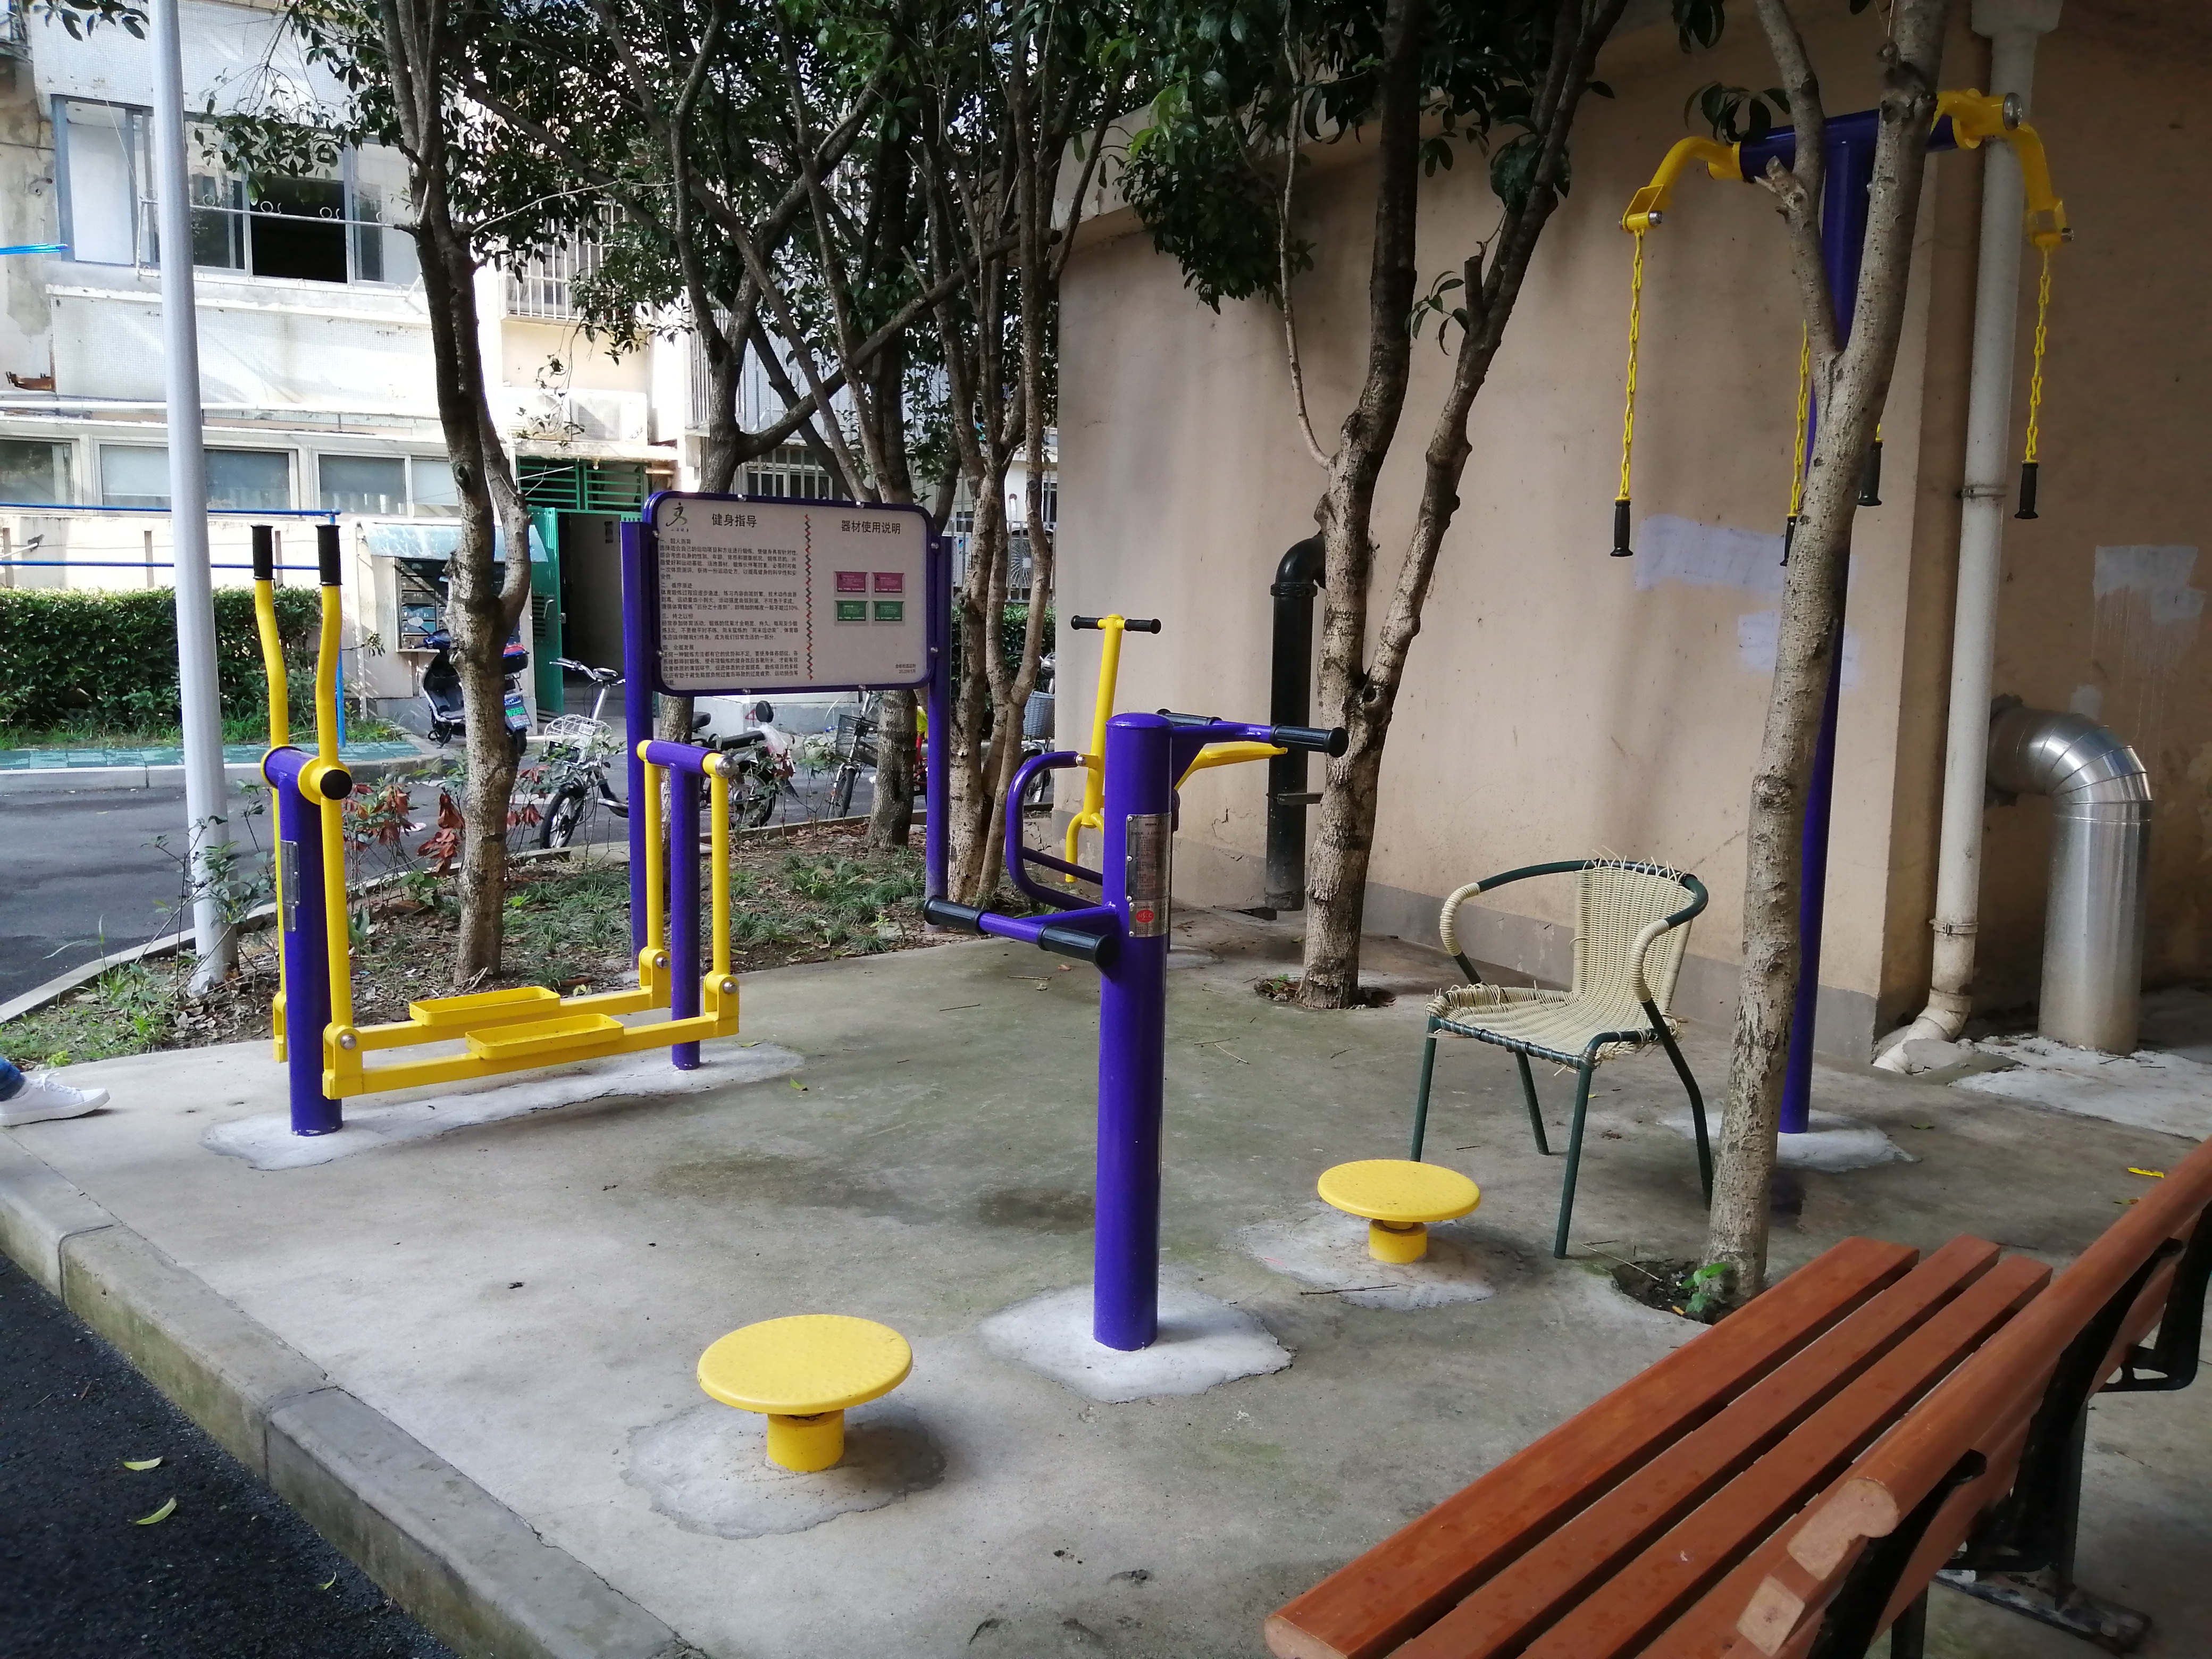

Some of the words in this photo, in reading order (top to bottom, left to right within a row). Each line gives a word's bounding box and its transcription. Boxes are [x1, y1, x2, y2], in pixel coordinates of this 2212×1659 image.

[711, 513, 757, 527] 健身指导
[841, 520, 901, 534] 器材使用说明
